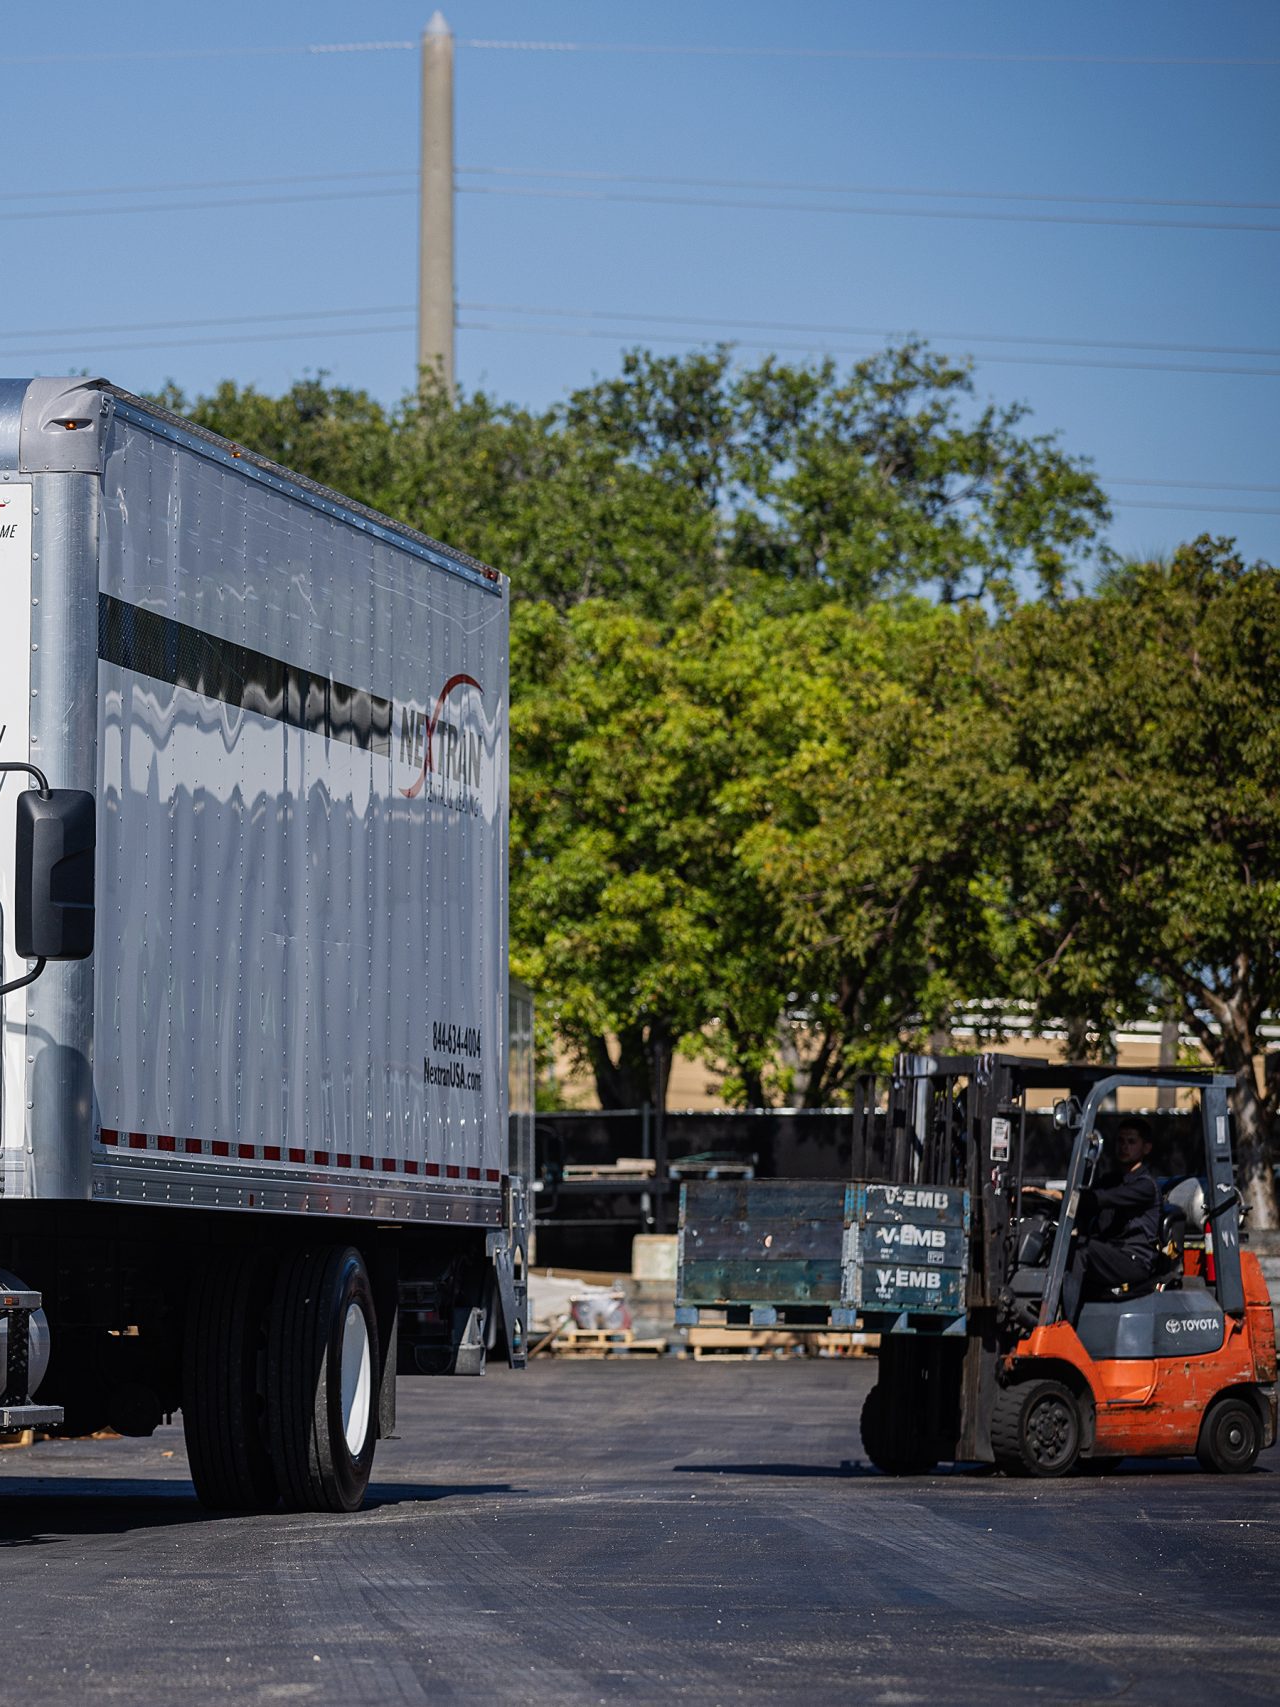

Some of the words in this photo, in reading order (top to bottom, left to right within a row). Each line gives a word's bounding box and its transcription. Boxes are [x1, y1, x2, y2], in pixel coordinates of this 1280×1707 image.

[400, 706, 483, 789] NEXTRAN
[432, 1021, 481, 1059] 844-634-4004
[423, 1056, 481, 1091] NextranUSA.com
[876, 1269, 941, 1289] V-EMB
[1181, 1318, 1219, 1331] TOYOTA
